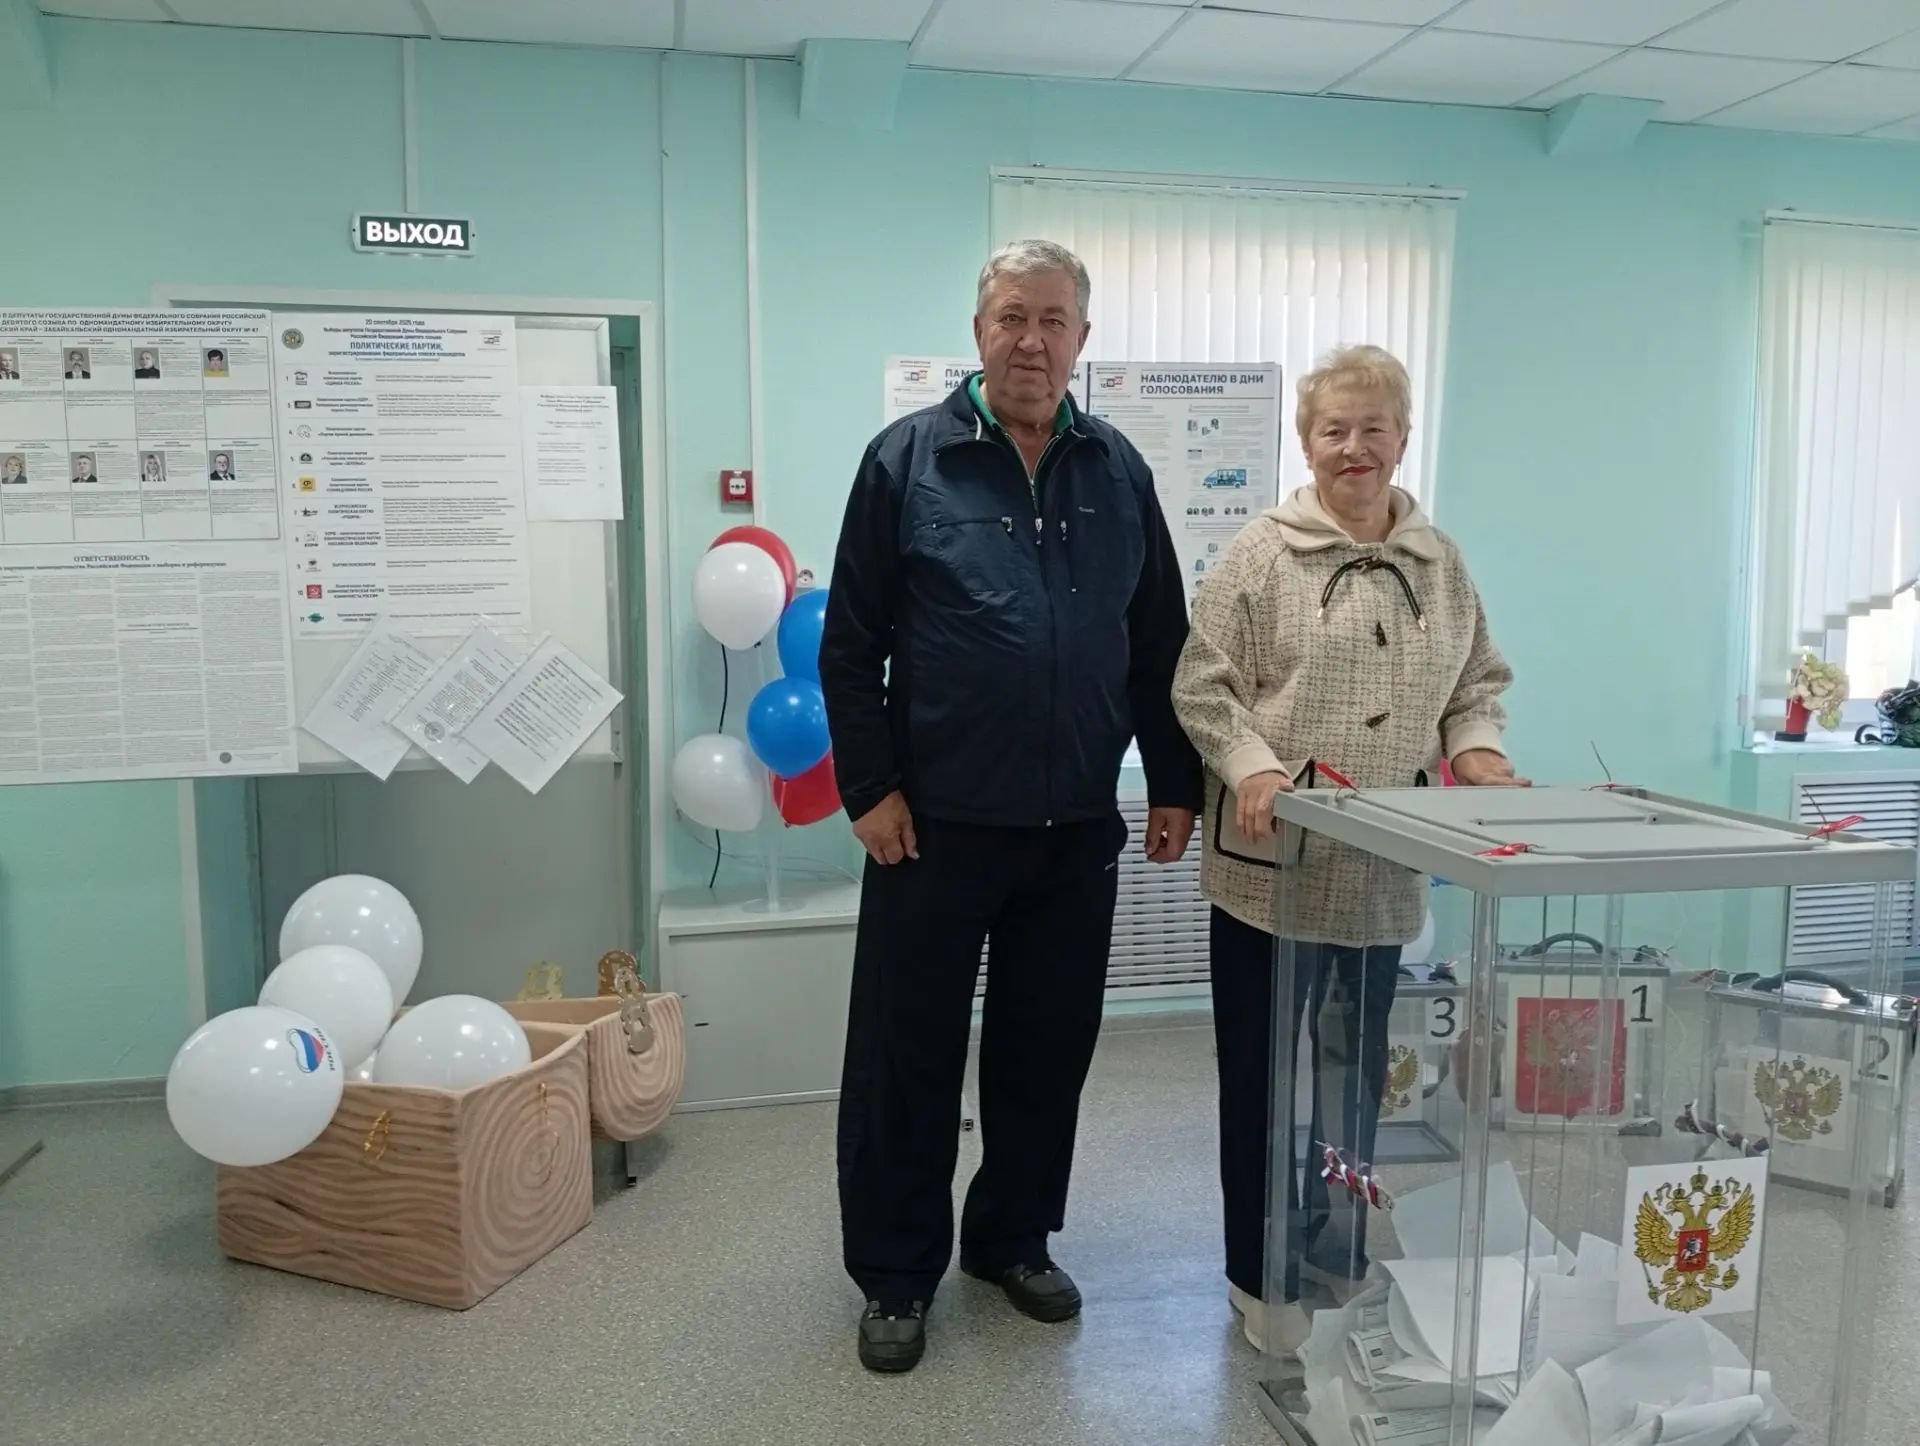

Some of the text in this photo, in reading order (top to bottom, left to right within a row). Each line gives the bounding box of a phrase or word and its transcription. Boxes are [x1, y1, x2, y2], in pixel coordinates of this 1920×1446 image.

[366, 221, 465, 247] ВЫХОД
[350, 341, 444, 351] ПОЛИТИЧЕСКИЕ ПАРТИИ,
[945, 368, 975, 379] ПАМ
[1140, 374, 1264, 384] НАБЛЮДАТЕЛЮ В ДНИ
[1140, 385, 1224, 395] ГОЛОСОВАНИЯ
[73, 554, 150, 562] ОТВЕТСТВЕННОСТЬ
[1630, 984, 1654, 1023] 1
[1431, 996, 1456, 1038] 3
[1857, 1035, 1890, 1081] 2
